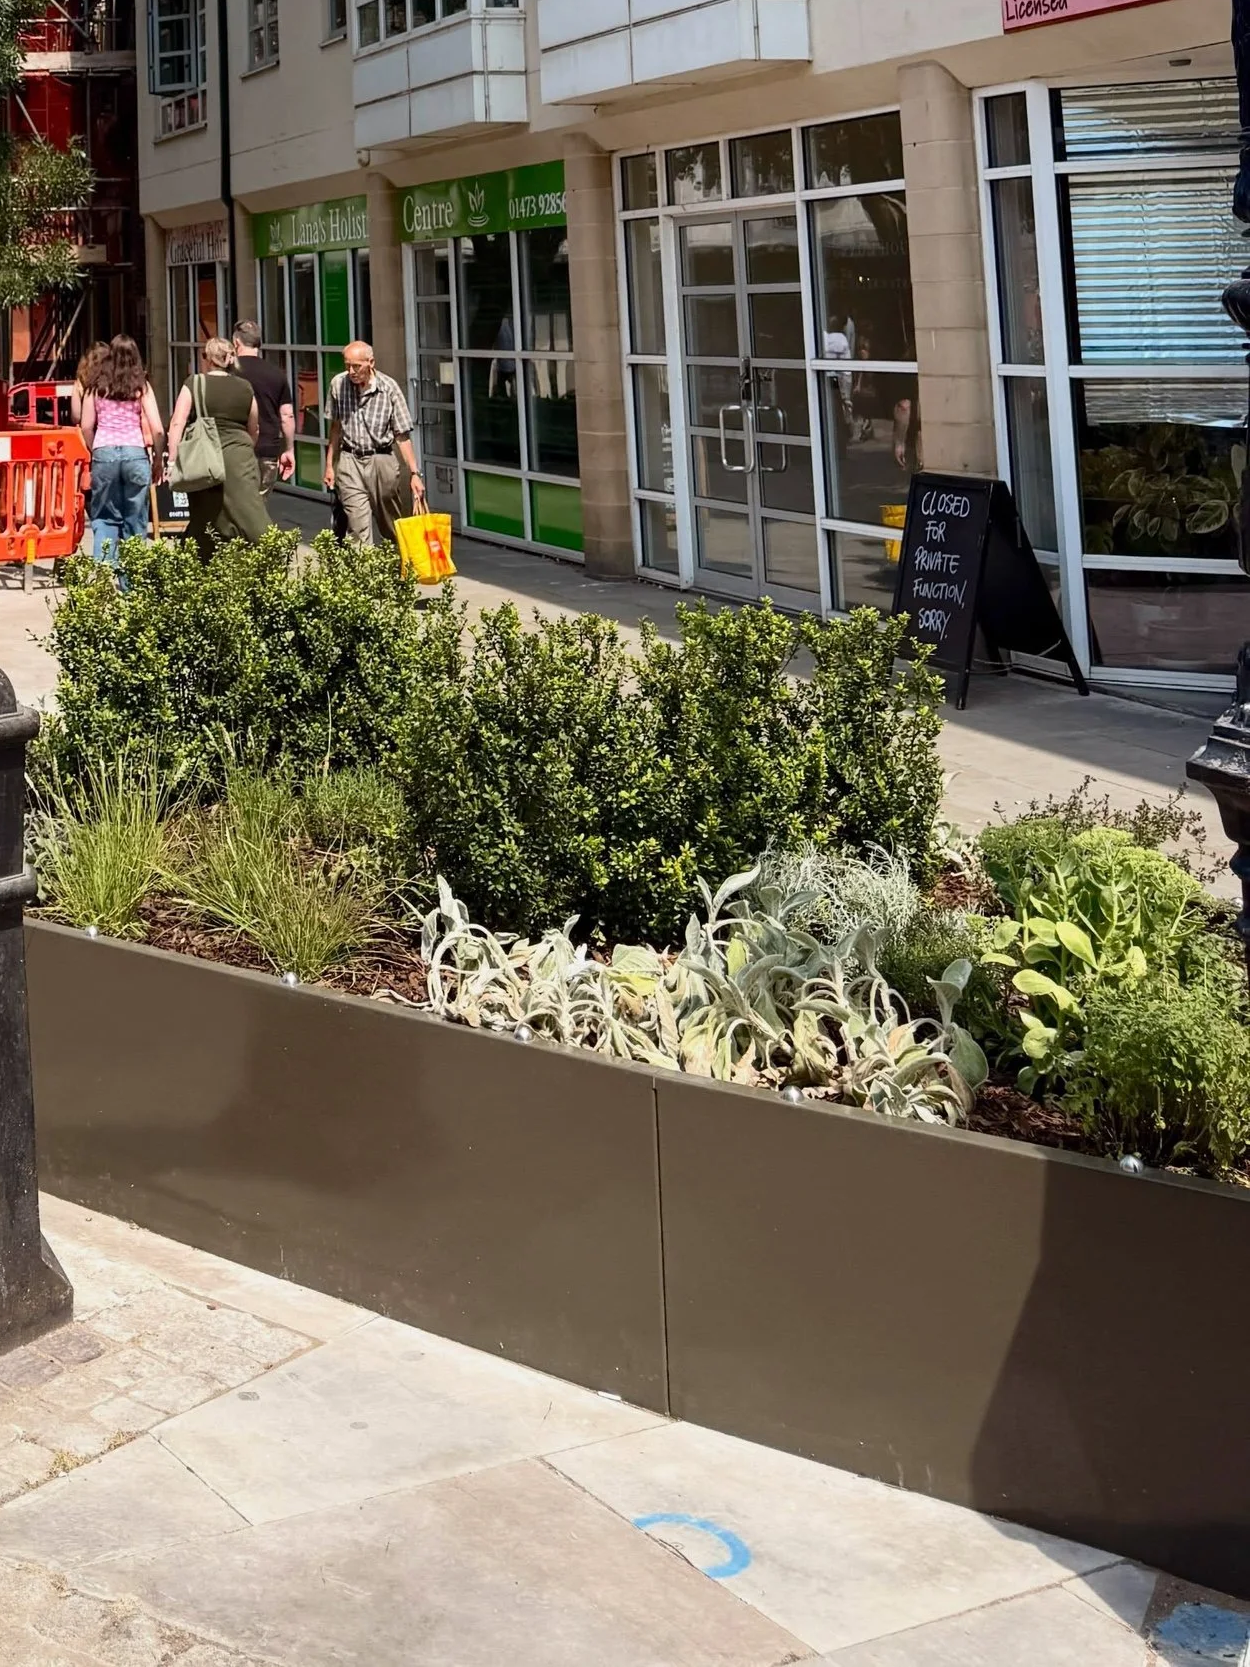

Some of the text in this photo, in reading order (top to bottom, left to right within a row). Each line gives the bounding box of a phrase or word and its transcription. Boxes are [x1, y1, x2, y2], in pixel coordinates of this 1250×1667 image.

[291, 205, 370, 246] Lana's Holist
[402, 195, 454, 234] Centre
[508, 195, 537, 220] 01473
[921, 490, 971, 518] CLOSED
[925, 520, 946, 544] FOR
[914, 546, 960, 575] PRIVATE
